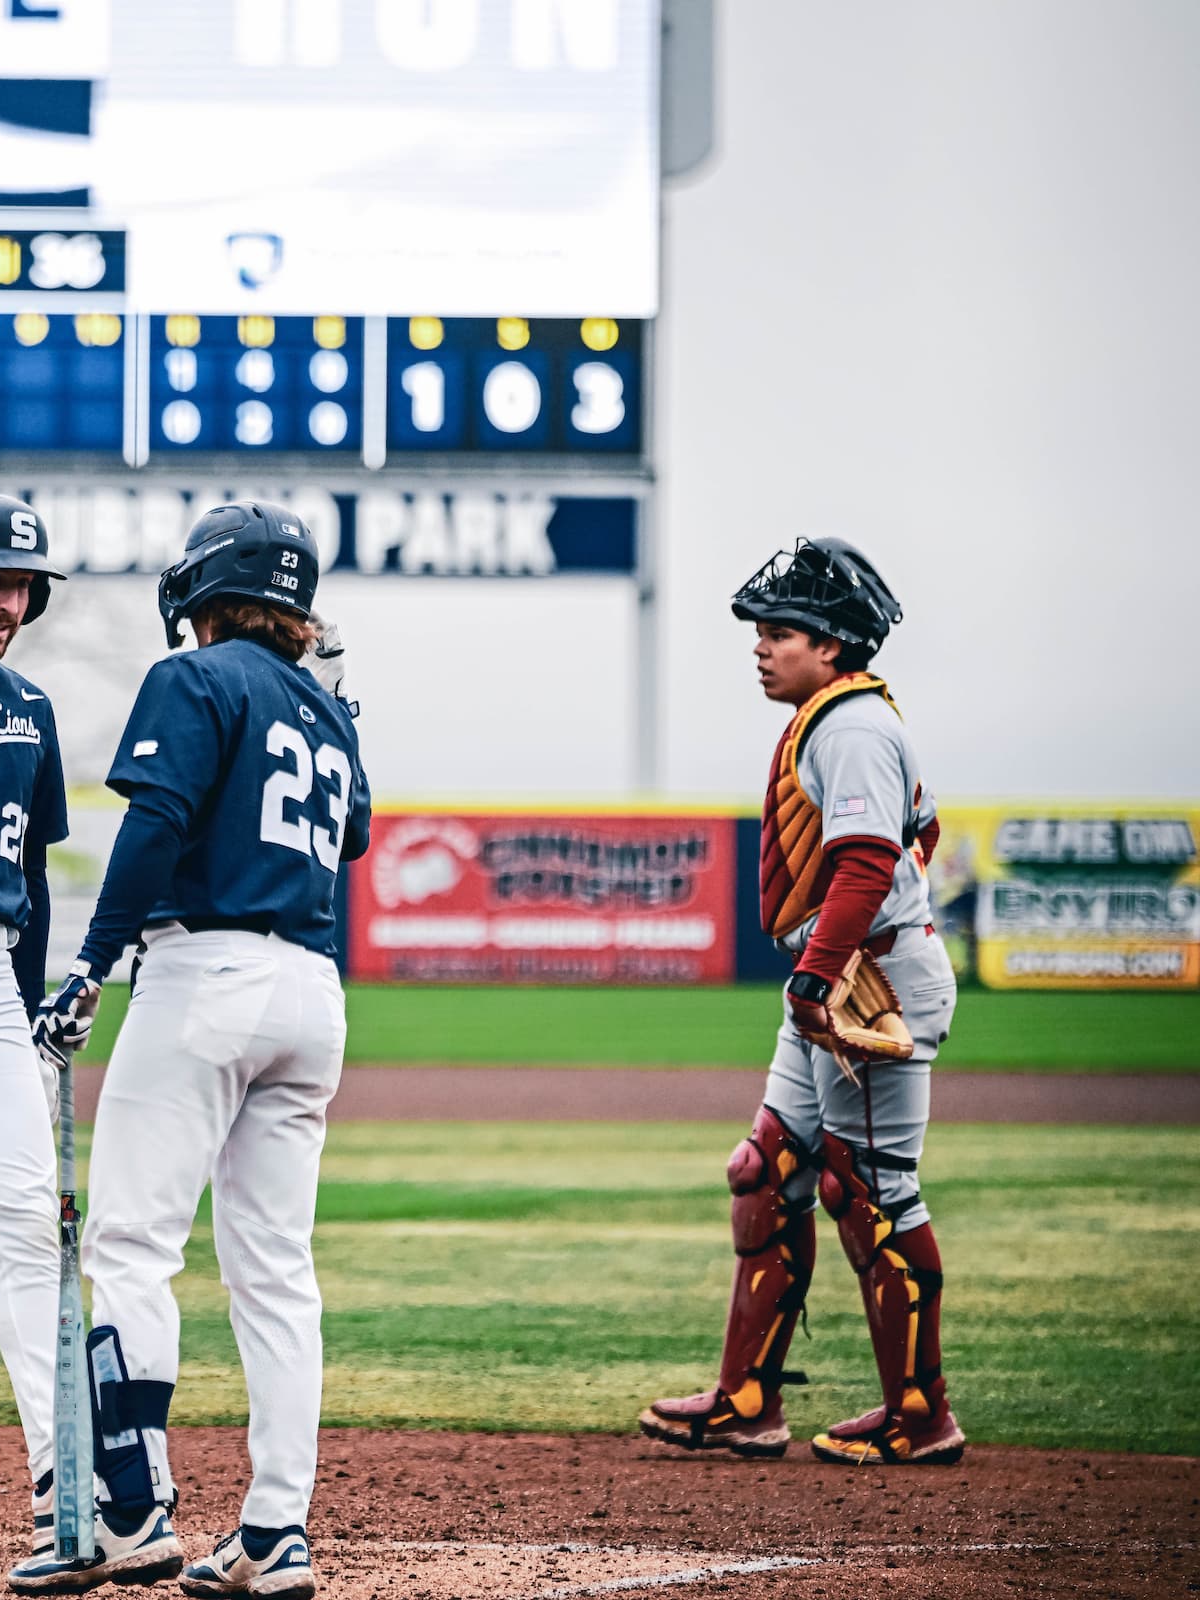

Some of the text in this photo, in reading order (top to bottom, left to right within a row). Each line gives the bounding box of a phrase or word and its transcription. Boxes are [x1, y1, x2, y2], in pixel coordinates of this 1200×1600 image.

[401, 361, 445, 432] 1
[483, 361, 541, 433] 0
[571, 361, 626, 434] 3
[11, 511, 37, 550] S
[281, 551, 299, 569] 23
[355, 490, 557, 578] PARK
[260, 720, 353, 874] 23
[0, 802, 29, 871] 2
